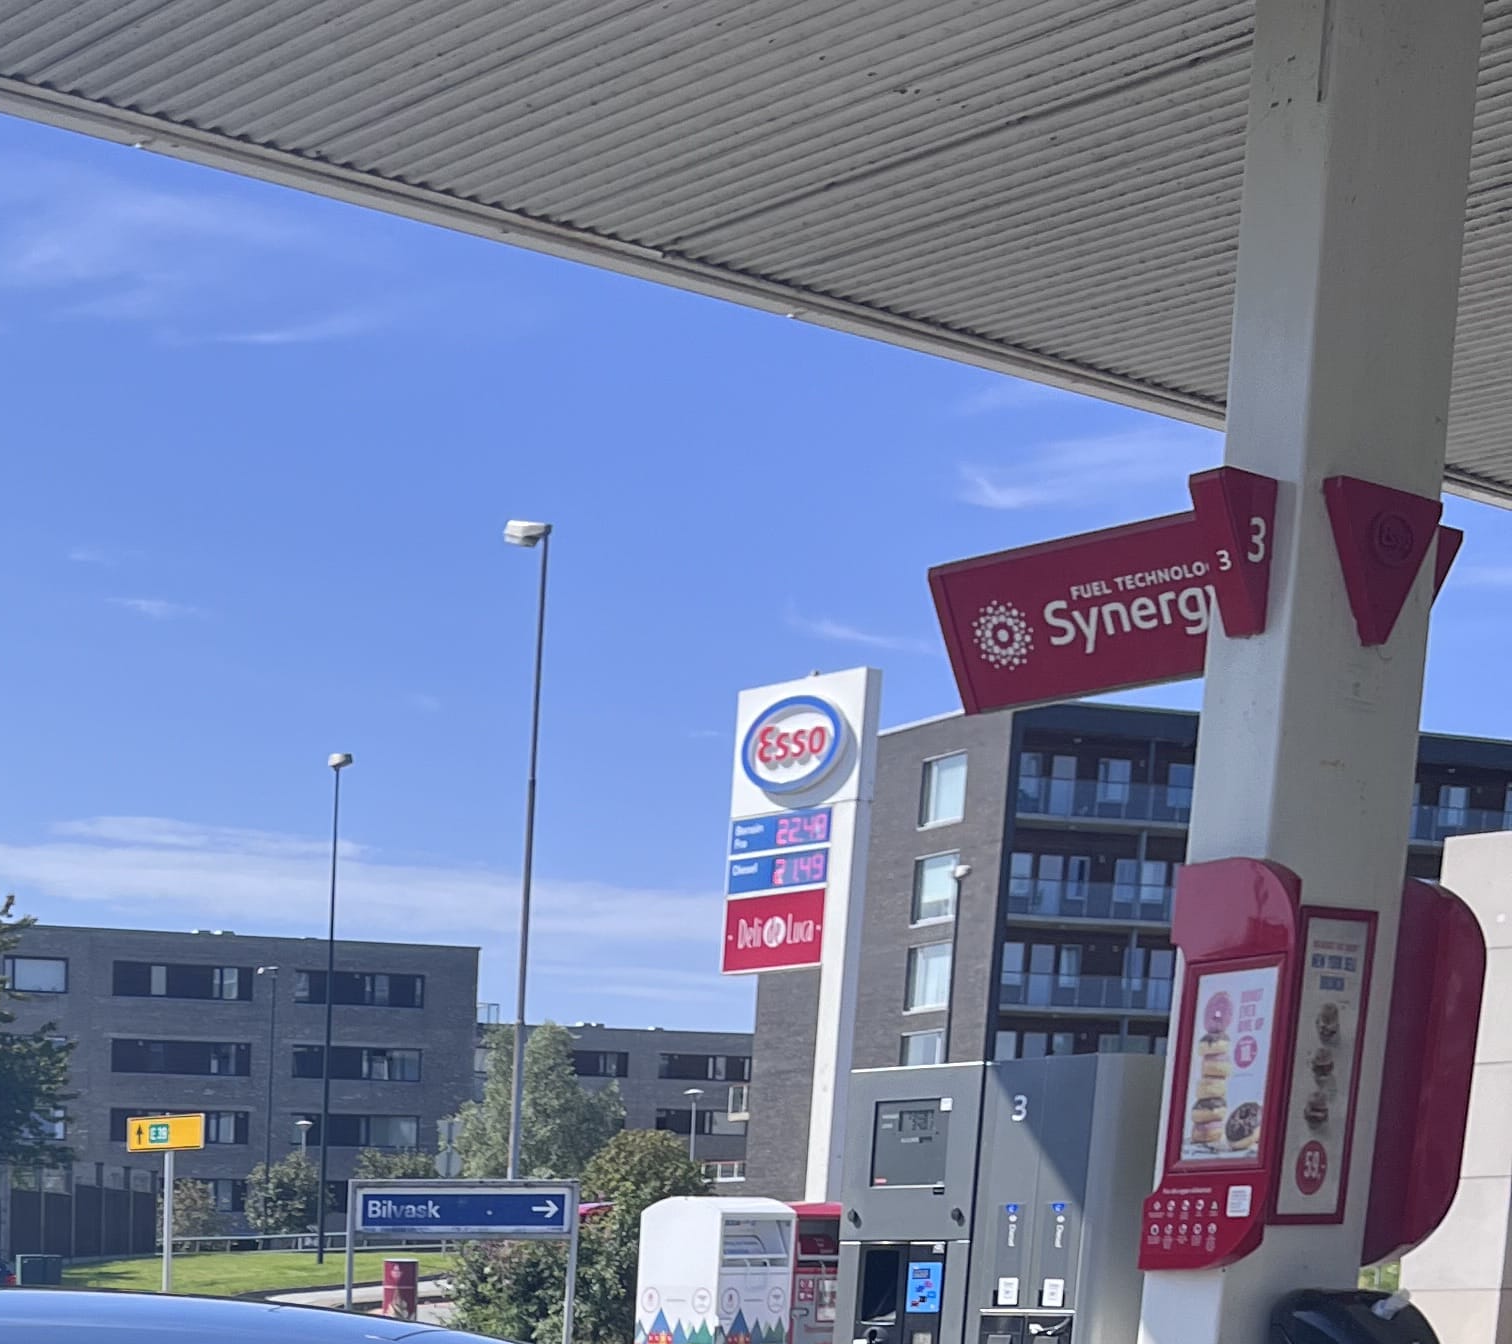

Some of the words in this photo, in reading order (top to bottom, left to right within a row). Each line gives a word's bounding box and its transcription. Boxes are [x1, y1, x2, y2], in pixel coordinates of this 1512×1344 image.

[1248, 516, 1266, 563] 3
[1215, 549, 1232, 571] 3
[1069, 580, 1112, 600] FUEL
[1113, 561, 1210, 592] TECHNOLO
[758, 726, 826, 763] Esso
[737, 918, 764, 949] Deli
[786, 913, 815, 944] Luca
[1011, 1094, 1028, 1121] 3
[367, 1200, 441, 1219] Bilvask
